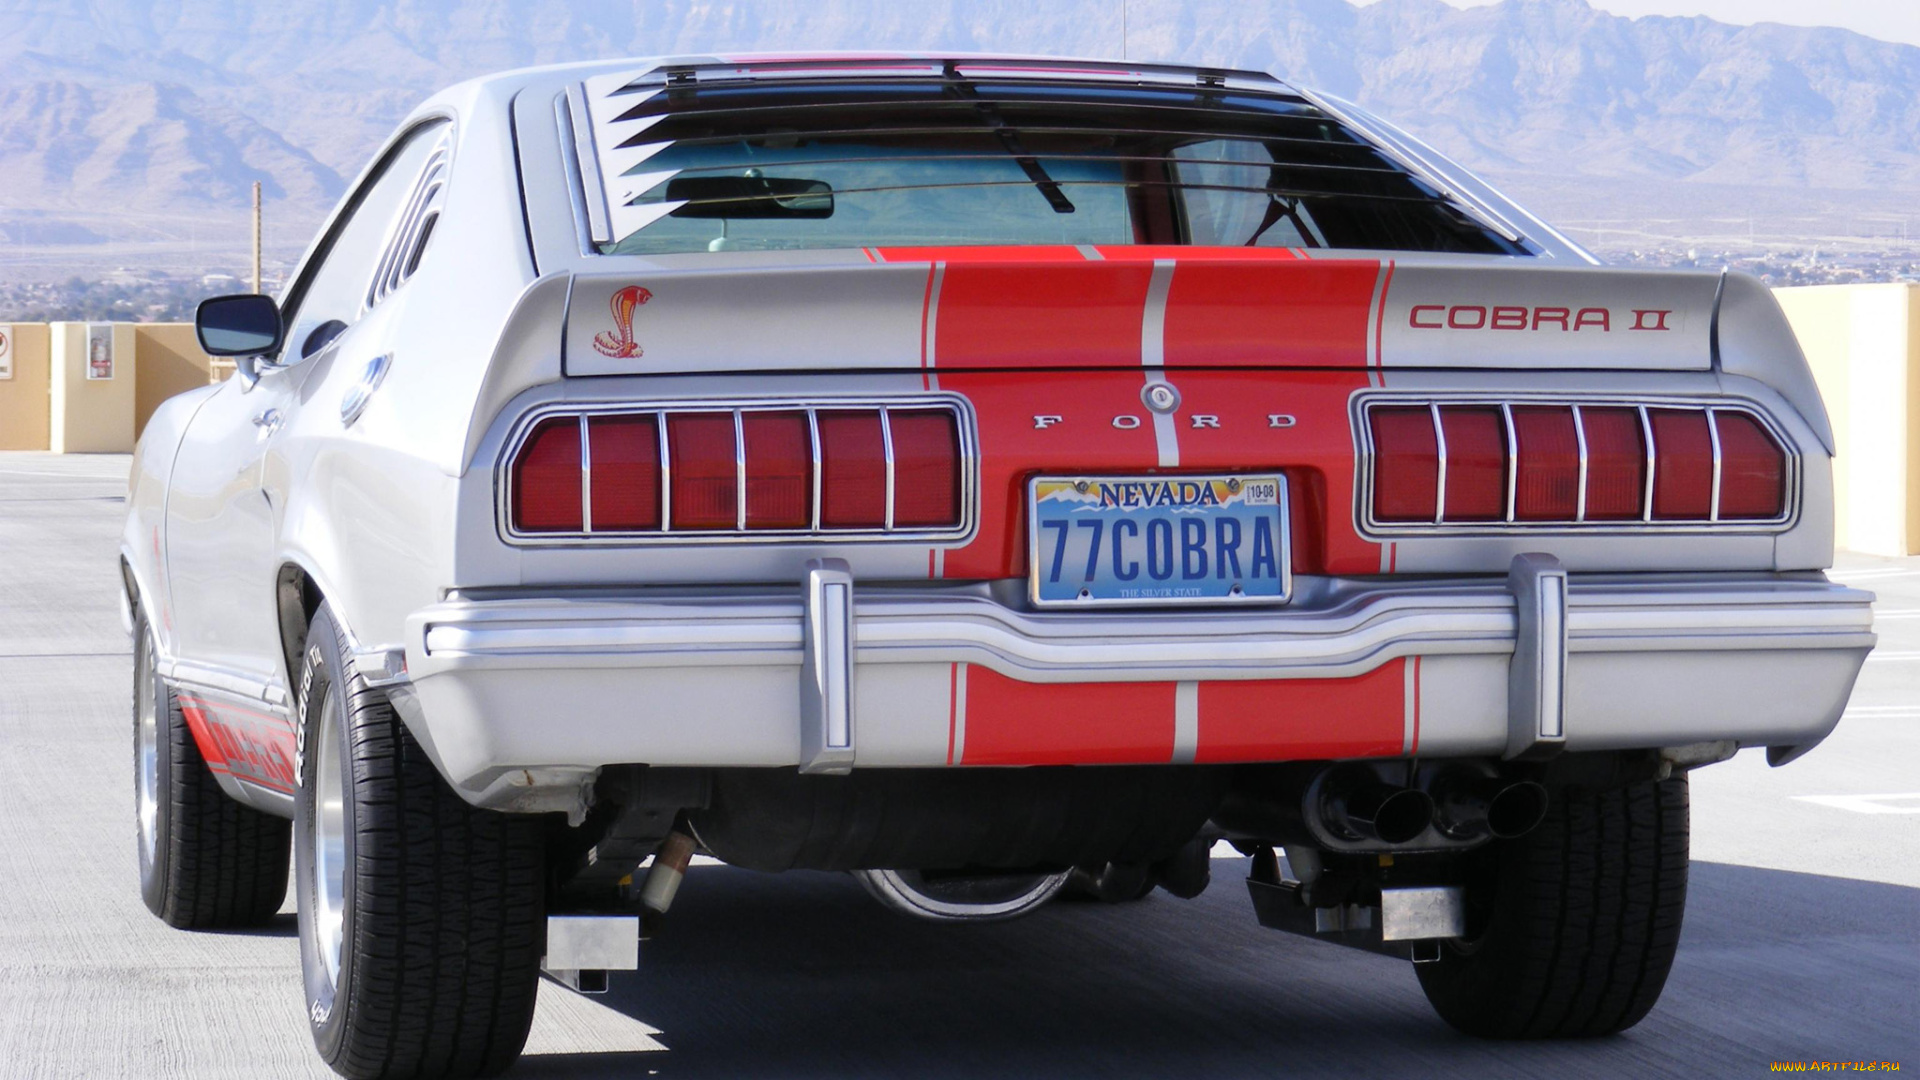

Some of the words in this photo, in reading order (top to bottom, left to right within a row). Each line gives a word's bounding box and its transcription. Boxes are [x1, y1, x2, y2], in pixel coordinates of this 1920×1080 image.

[1409, 304, 1610, 332] COBRA
[1628, 309, 1672, 331] II
[1033, 413, 1297, 430] FORD
[1099, 480, 1220, 508] NEVADA
[1250, 484, 1274, 498] 10-08
[1042, 515, 1278, 584] 77COBRA
[1120, 588, 1139, 598] THE
[1140, 588, 1172, 598] SILVER
[1173, 587, 1202, 597] STATE
[294, 658, 313, 788] Radial
